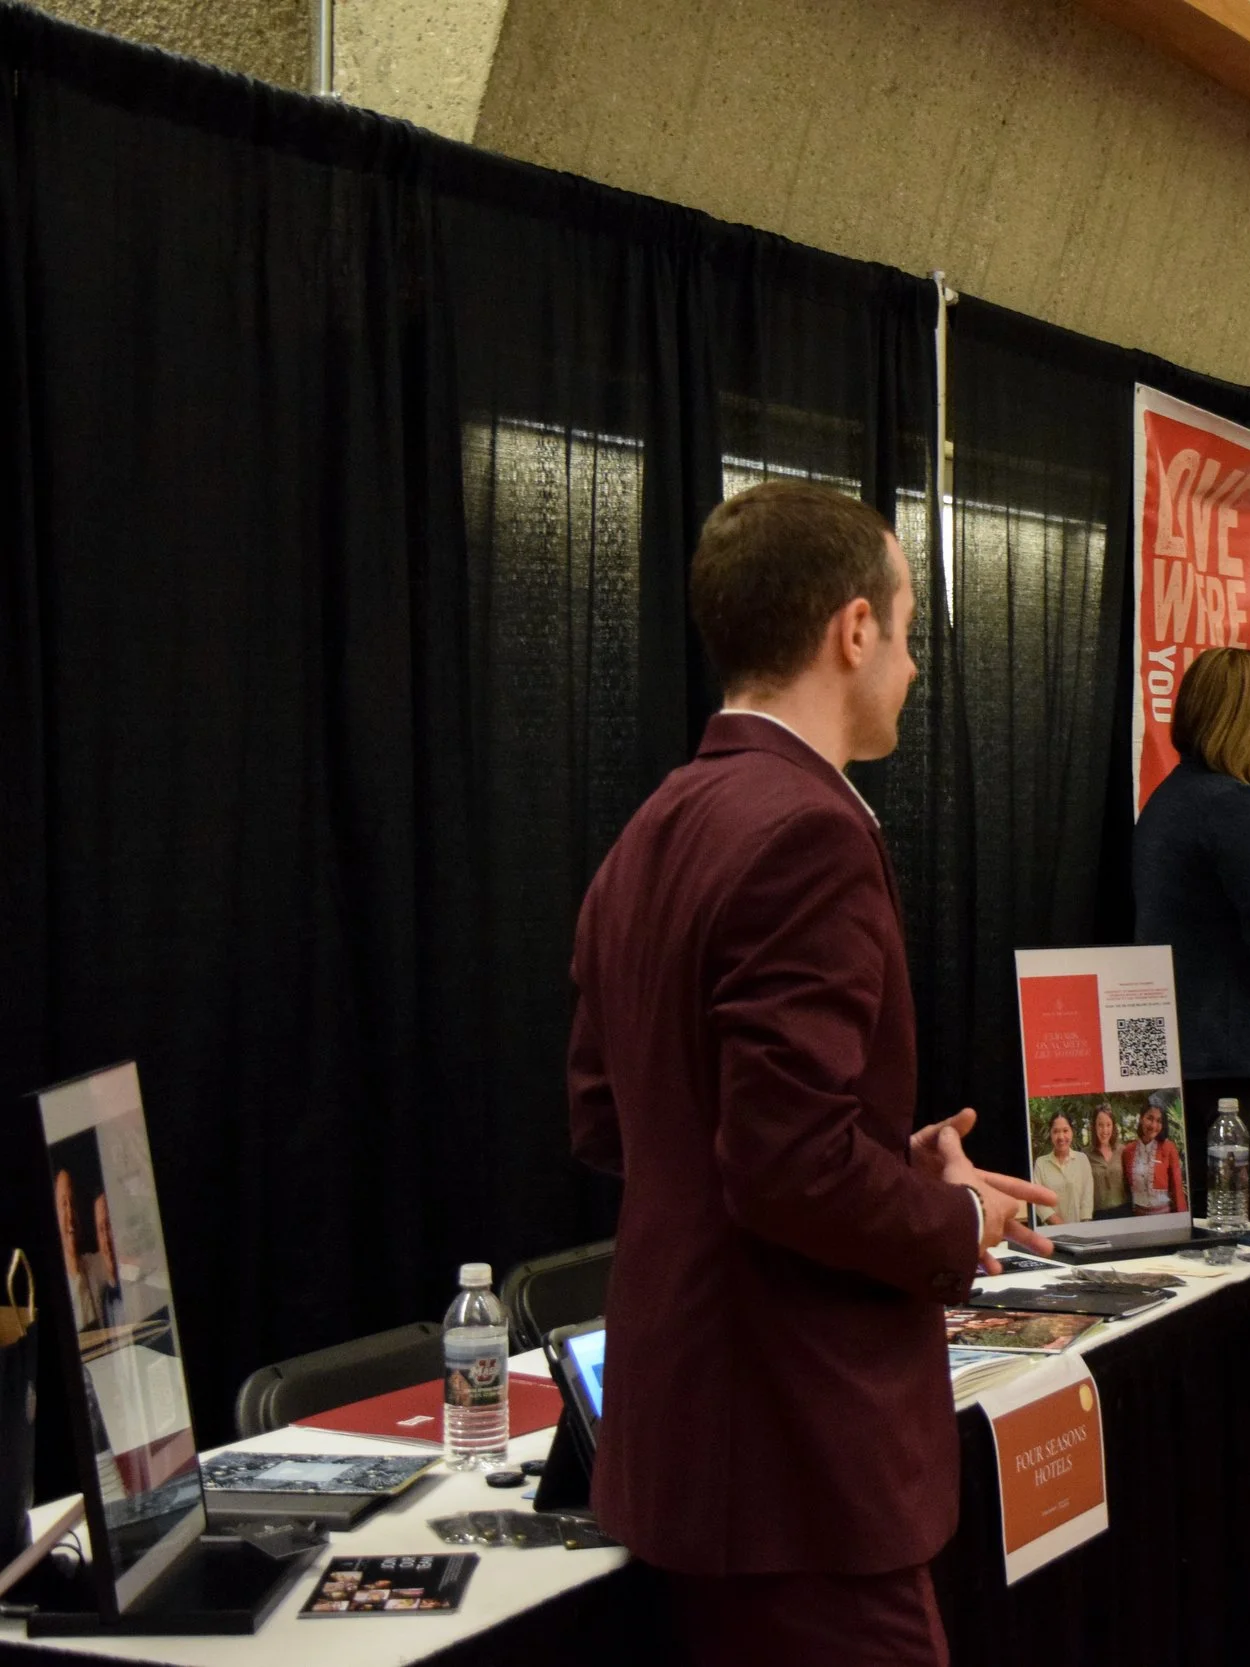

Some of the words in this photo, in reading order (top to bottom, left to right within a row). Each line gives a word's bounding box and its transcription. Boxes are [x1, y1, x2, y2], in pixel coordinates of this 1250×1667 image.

[1148, 644, 1177, 723] YOU
[1016, 1445, 1044, 1473] FOUR
[1045, 1424, 1087, 1458] SEASONS
[1034, 1454, 1073, 1487] HOTELS
